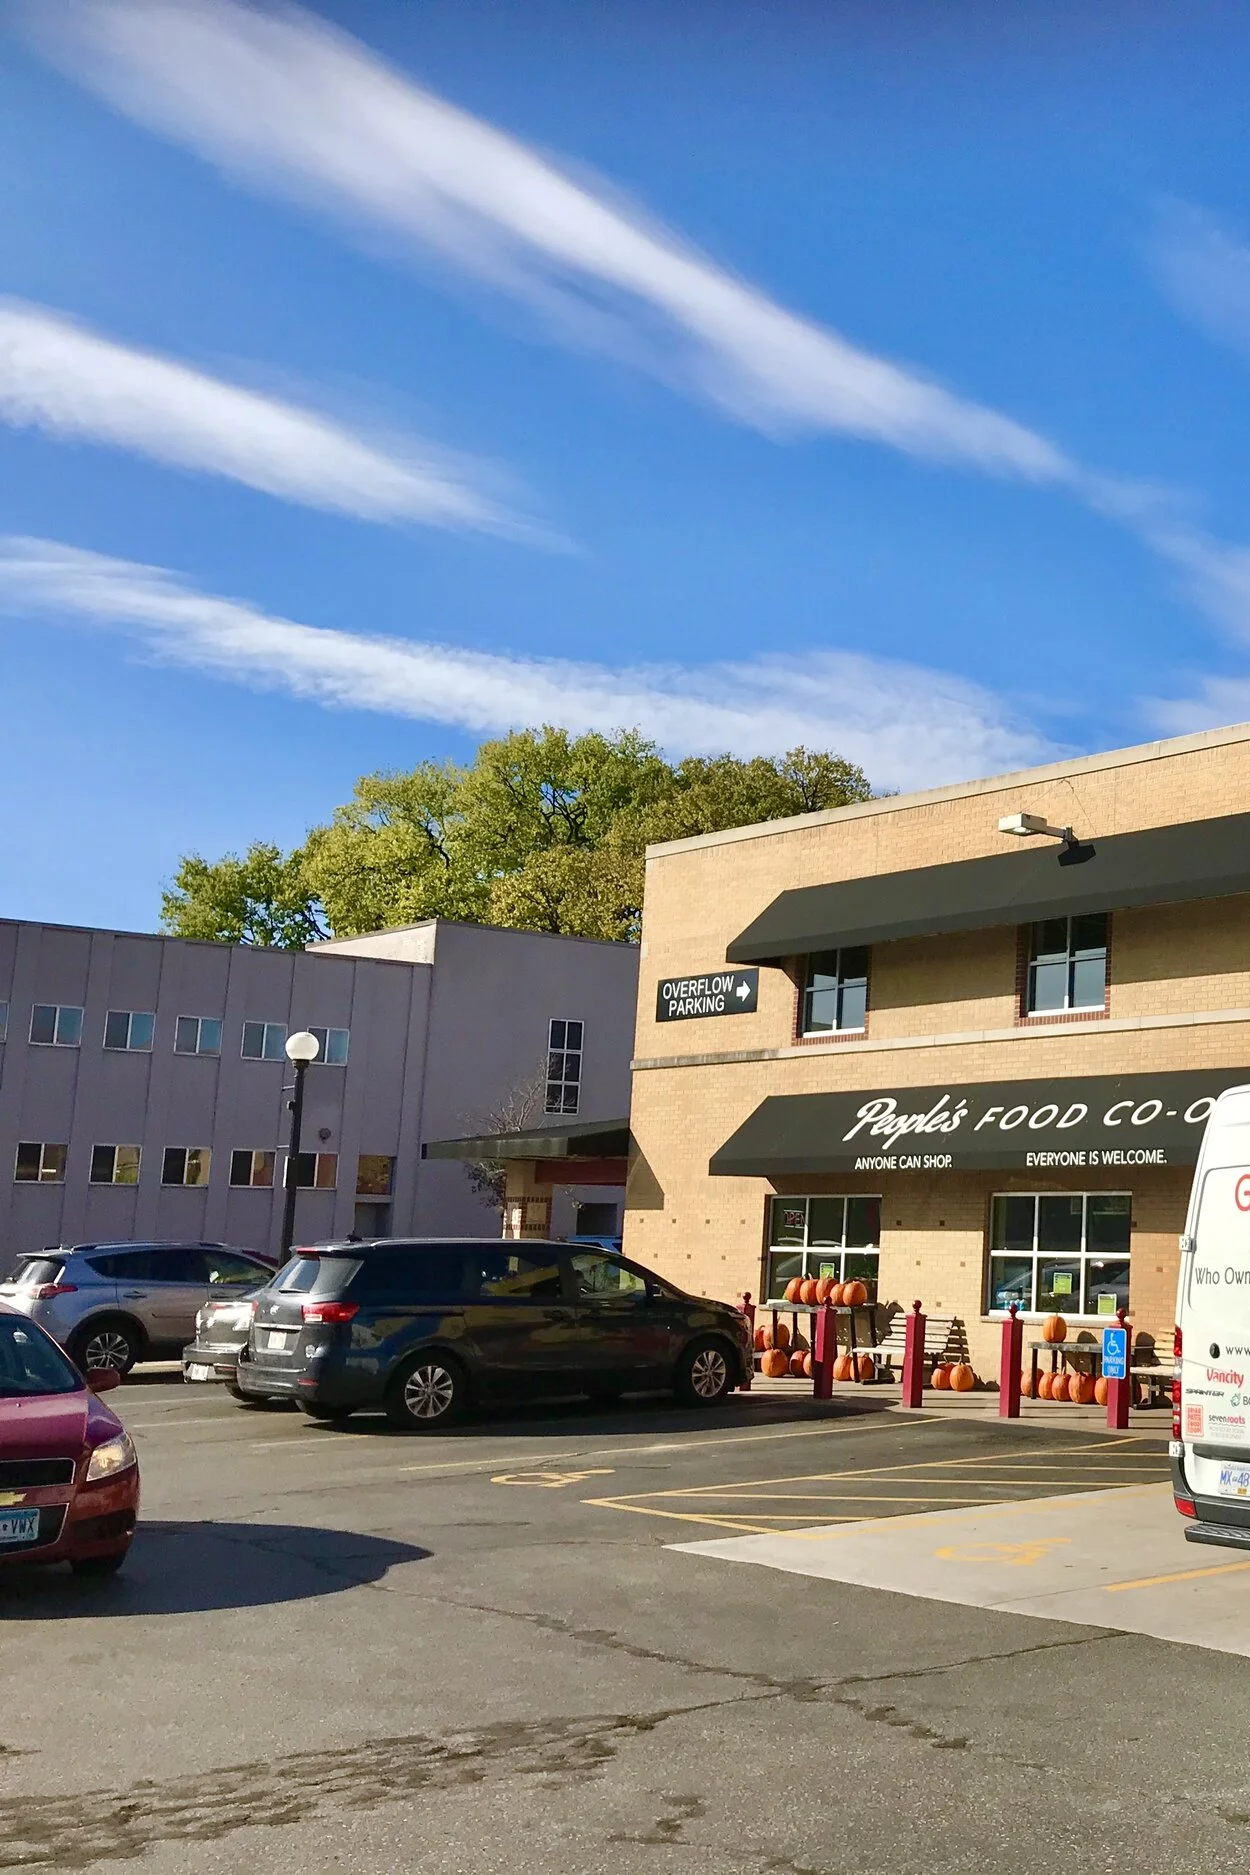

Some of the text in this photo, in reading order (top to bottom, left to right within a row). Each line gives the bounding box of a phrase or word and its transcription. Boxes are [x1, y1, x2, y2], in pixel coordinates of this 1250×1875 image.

[663, 975, 734, 999] OVERFLOW
[668, 995, 725, 1017] PARKING
[842, 1094, 1217, 1150] People's FOOD CO-O
[854, 1154, 953, 1170] ANYONE CAN SHOP.
[1026, 1149, 1168, 1167] EVERYONE IS WELCOME.
[1195, 1268, 1220, 1285] Who
[1207, 1368, 1244, 1388] Vancity
